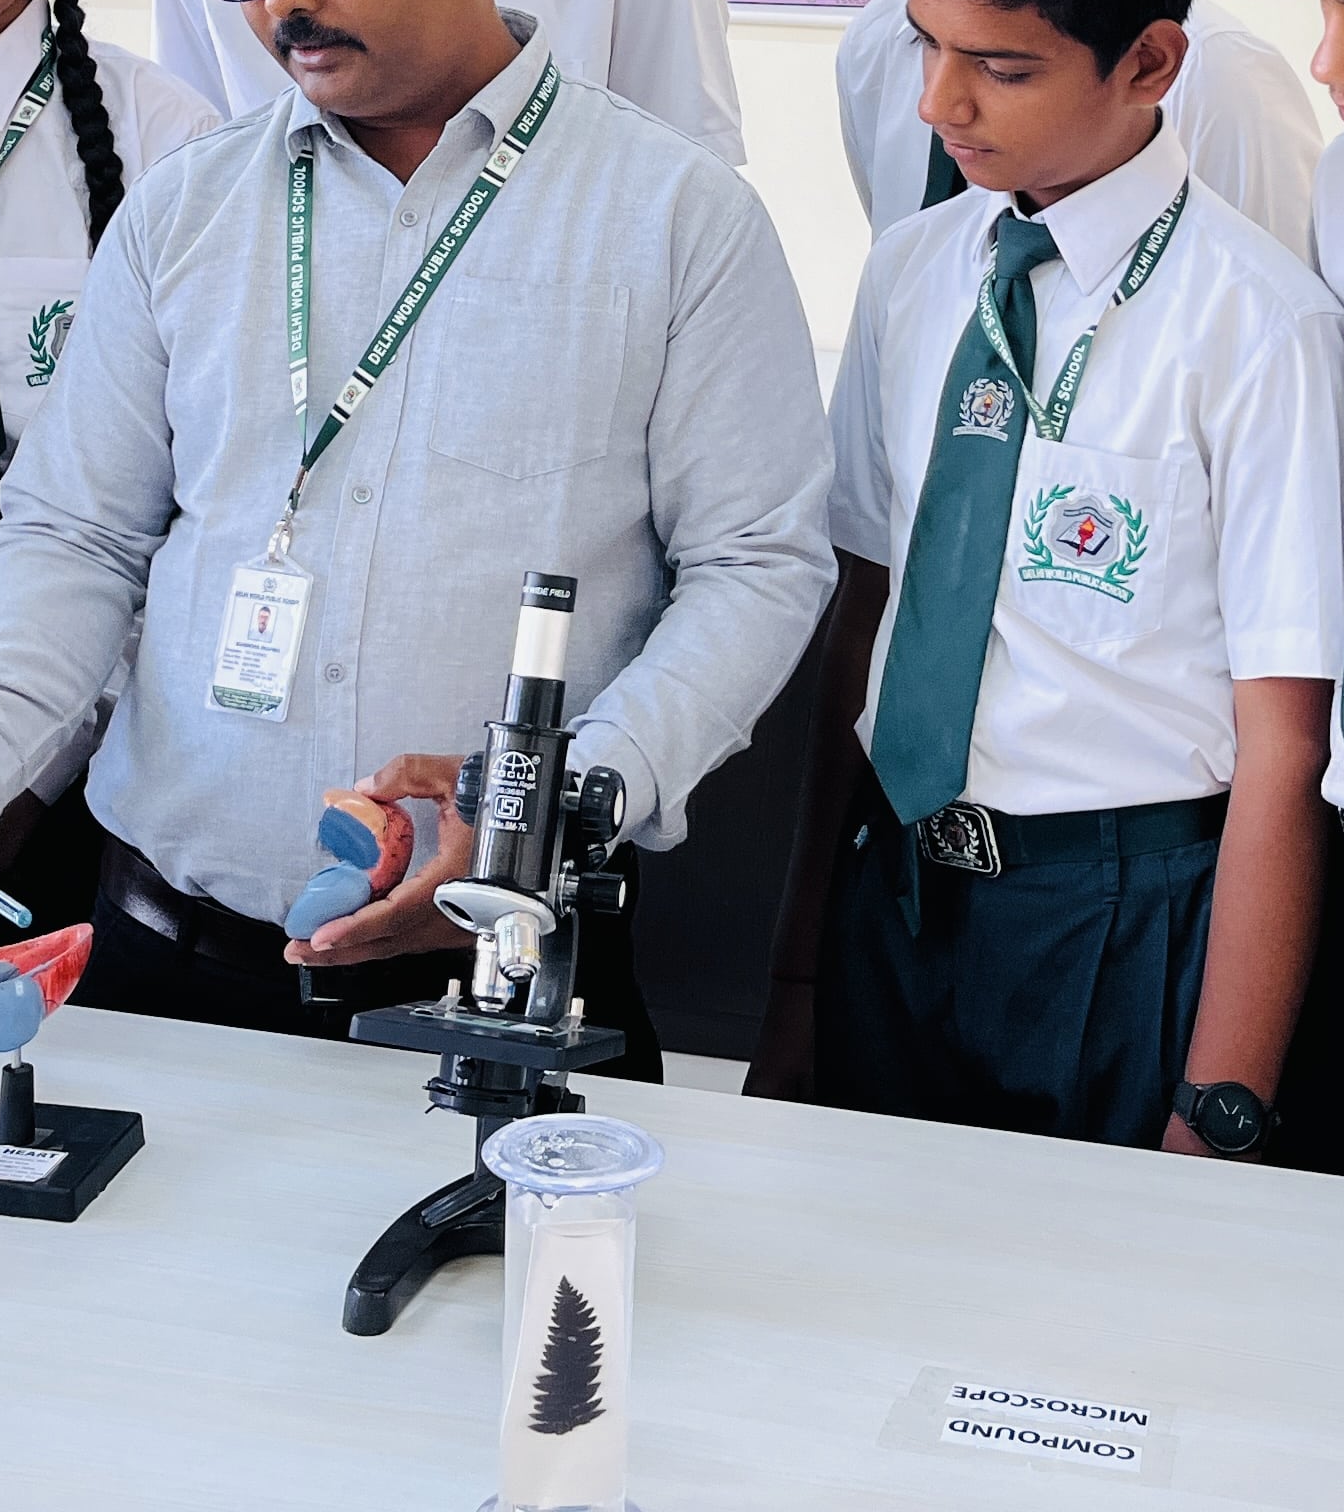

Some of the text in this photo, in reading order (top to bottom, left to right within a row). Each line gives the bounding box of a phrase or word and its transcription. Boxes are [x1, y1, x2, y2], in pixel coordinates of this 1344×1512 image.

[517, 66, 557, 134] DELHI WORLD
[291, 165, 306, 352] DELHI WORLD PUBLIC SCHOOL
[367, 188, 489, 366] DELHI WORLD PUBLIC SCHOOL
[1128, 212, 1174, 290] DELHI WORLD
[1059, 344, 1085, 401] SCHOOL
[549, 588, 571, 599] FIELD
[5, 1148, 60, 1160] HEART
[951, 1386, 1148, 1426] MICROSCOPE
[948, 1420, 1136, 1461] COMPOUND
